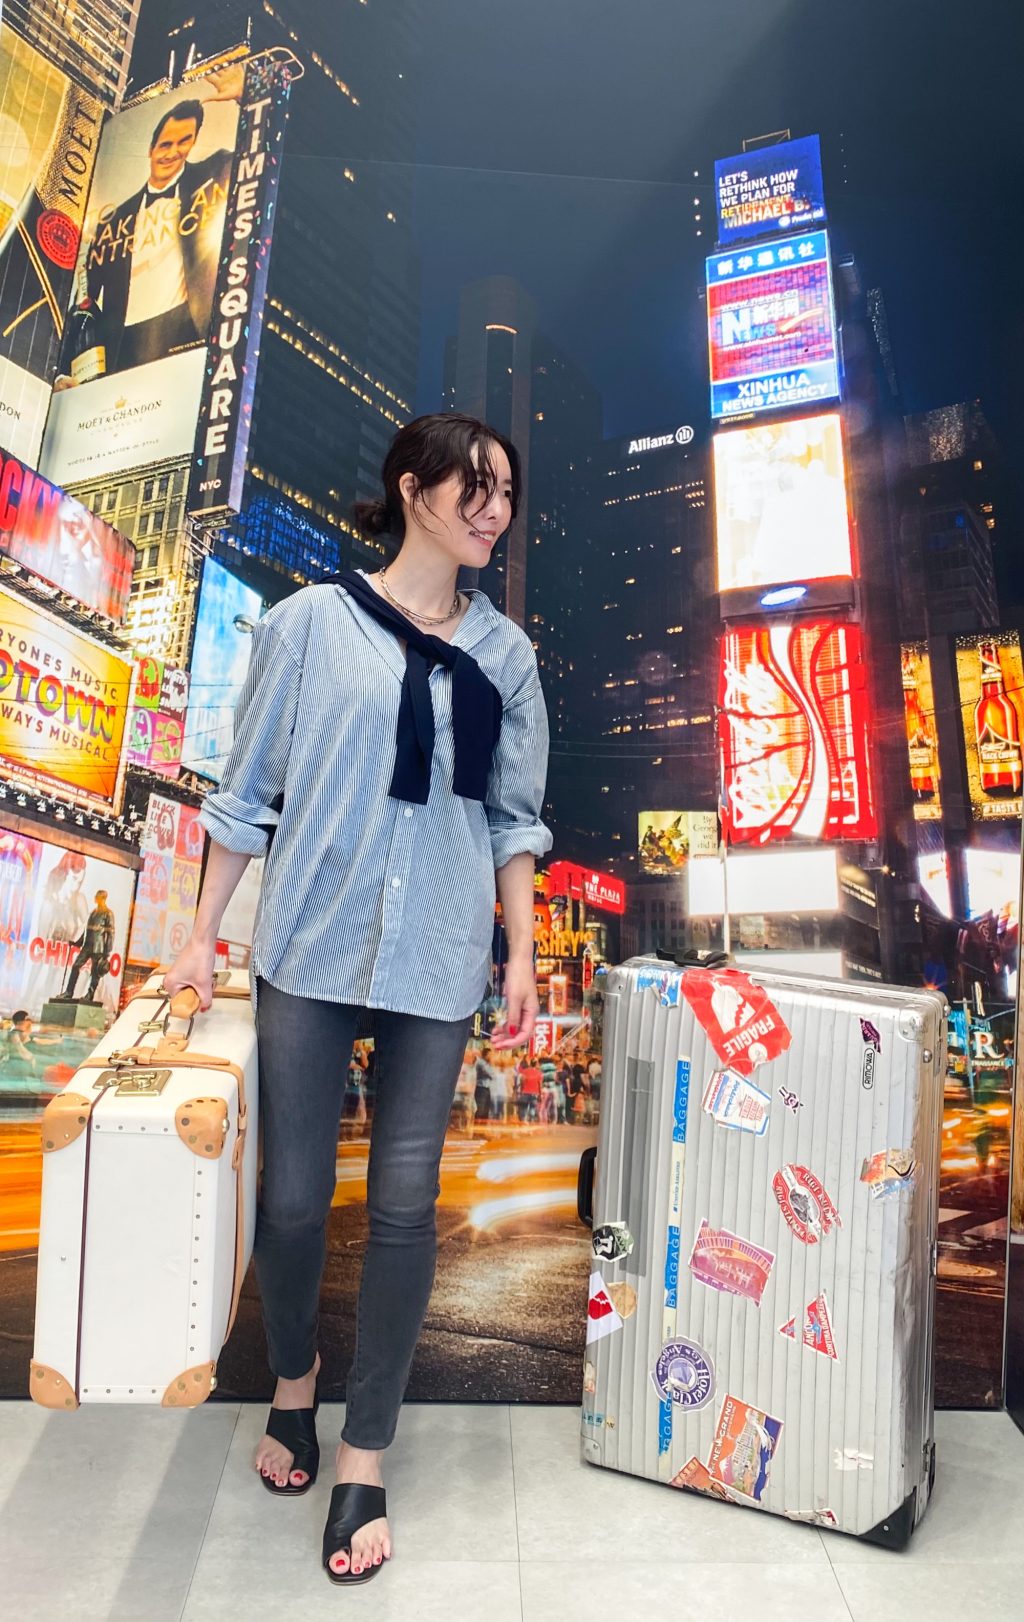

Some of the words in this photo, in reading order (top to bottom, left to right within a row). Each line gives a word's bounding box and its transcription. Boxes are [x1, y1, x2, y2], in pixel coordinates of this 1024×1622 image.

[233, 98, 272, 240] TIMES
[719, 170, 748, 187] LET'S
[719, 176, 768, 198] RETHINK
[770, 168, 798, 185] HOW
[720, 195, 738, 208] WE
[741, 187, 770, 203] PLAN
[773, 181, 795, 196] FOR
[724, 202, 790, 229] MICHAEL
[204, 255, 249, 457] SQUARE
[722, 394, 764, 413] NEWS
[768, 383, 829, 406] AGENCY
[738, 373, 810, 399] XINHUA
[113, 399, 163, 424] CHANDON
[628, 433, 676, 454] Allianz
[199, 478, 222, 492] NYC
[585, 881, 599, 894] THE
[600, 886, 621, 903] PLAZA
[721, 1013, 776, 1058] FRAGILE
[864, 1051, 874, 1086] RIMOWA
[676, 1060, 691, 1143] BAGGAGE
[802, 1172, 820, 1193] RIGI
[666, 1226, 681, 1308] BAGGAGE
[658, 1343, 683, 1375] Angeles
[685, 1347, 702, 1367] Los
[687, 1367, 710, 1403] Hotel
[712, 1439, 723, 1461] NEW
[718, 1400, 734, 1437] GRAND
